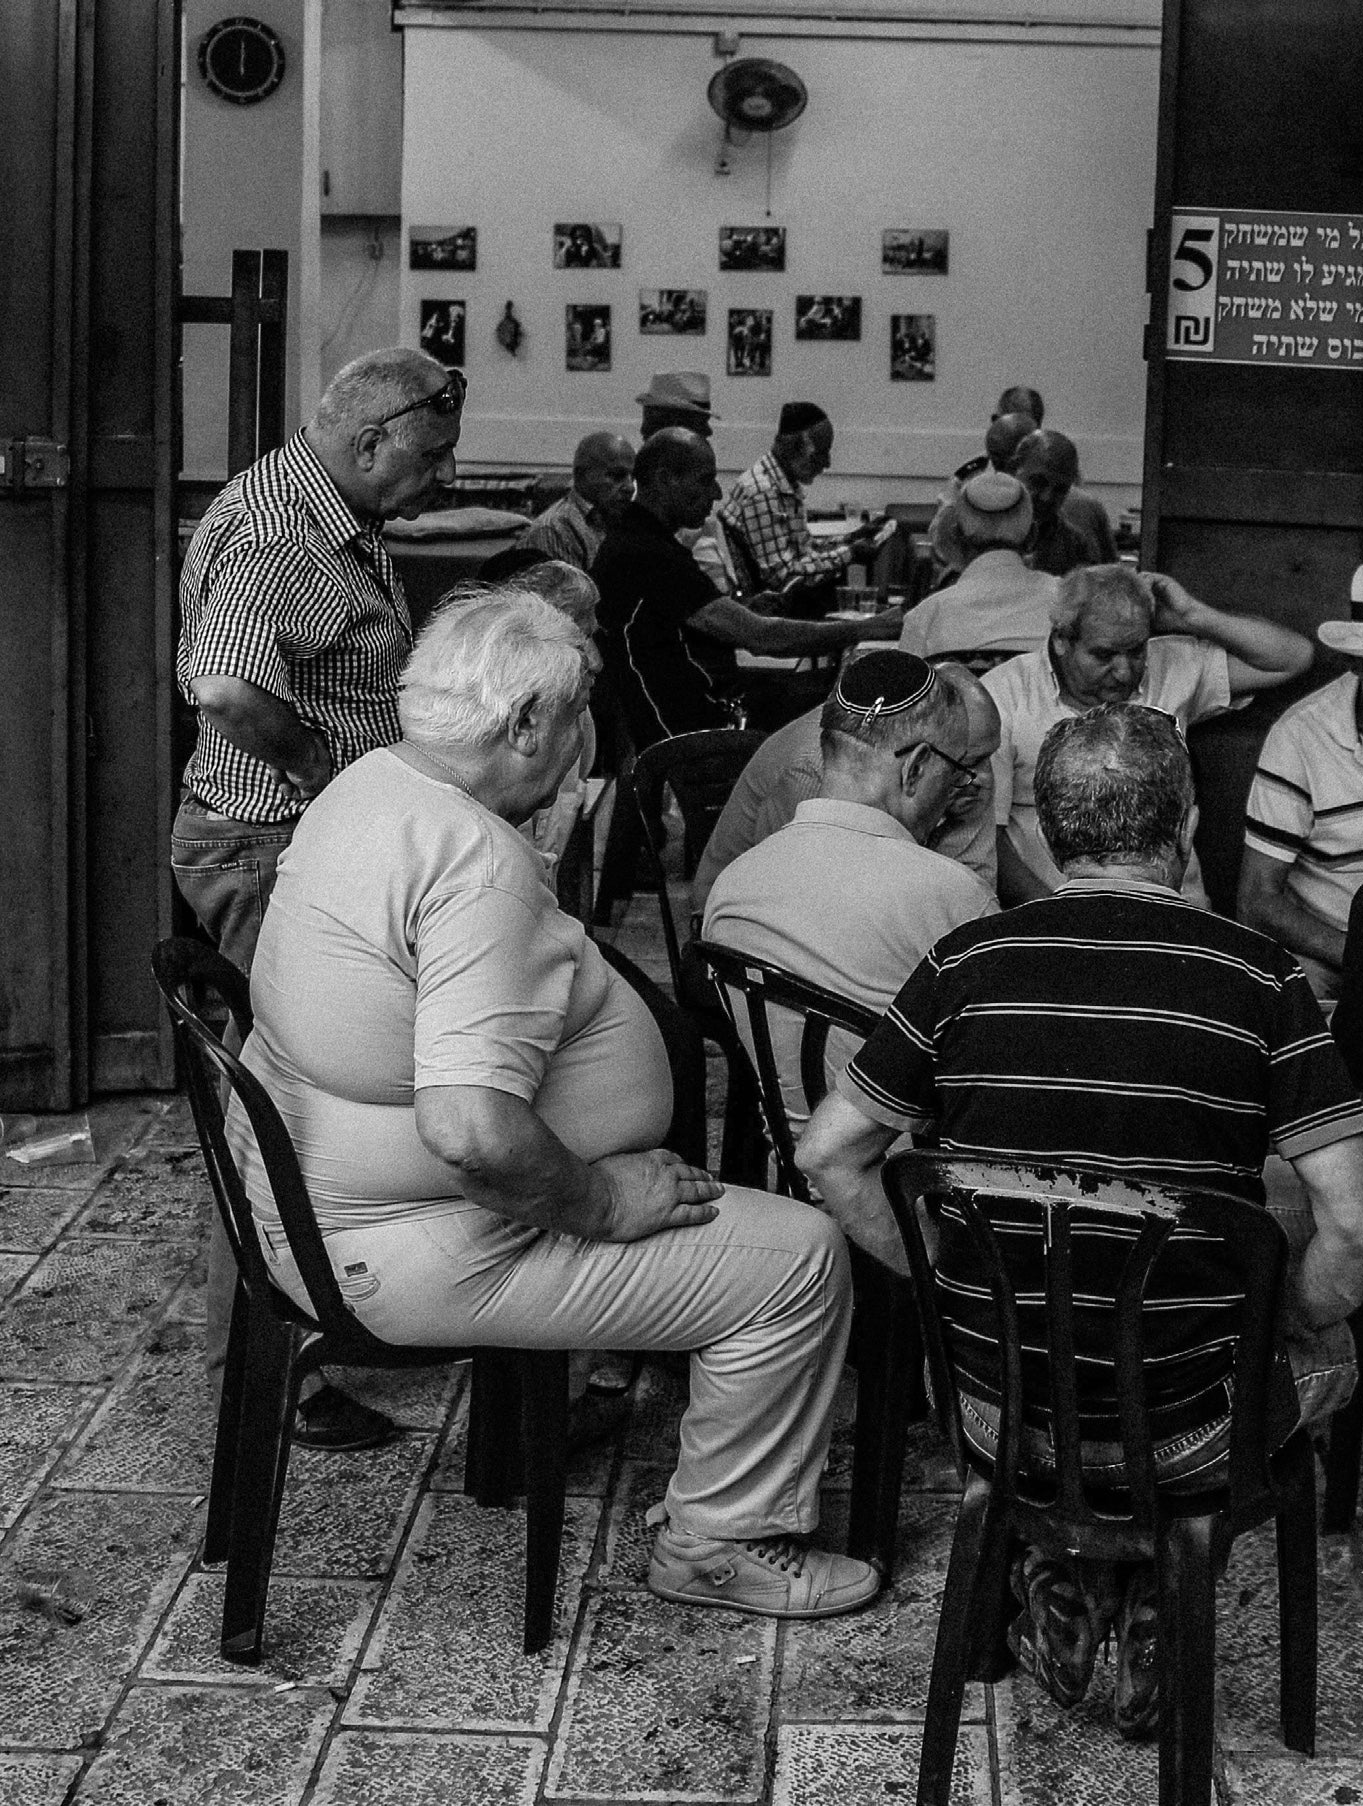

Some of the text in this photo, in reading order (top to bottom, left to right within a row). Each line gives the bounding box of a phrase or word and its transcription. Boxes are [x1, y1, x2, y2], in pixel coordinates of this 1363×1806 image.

[1224, 223, 1309, 249] שמשחק
[1317, 227, 1341, 249] מי
[1172, 228, 1216, 291] 5
[1226, 260, 1285, 283] שתיה
[1294, 256, 1314, 284] לו
[1218, 295, 1282, 322] משחק
[1290, 292, 1338, 322] שלא
[1252, 334, 1318, 358] שתיה
